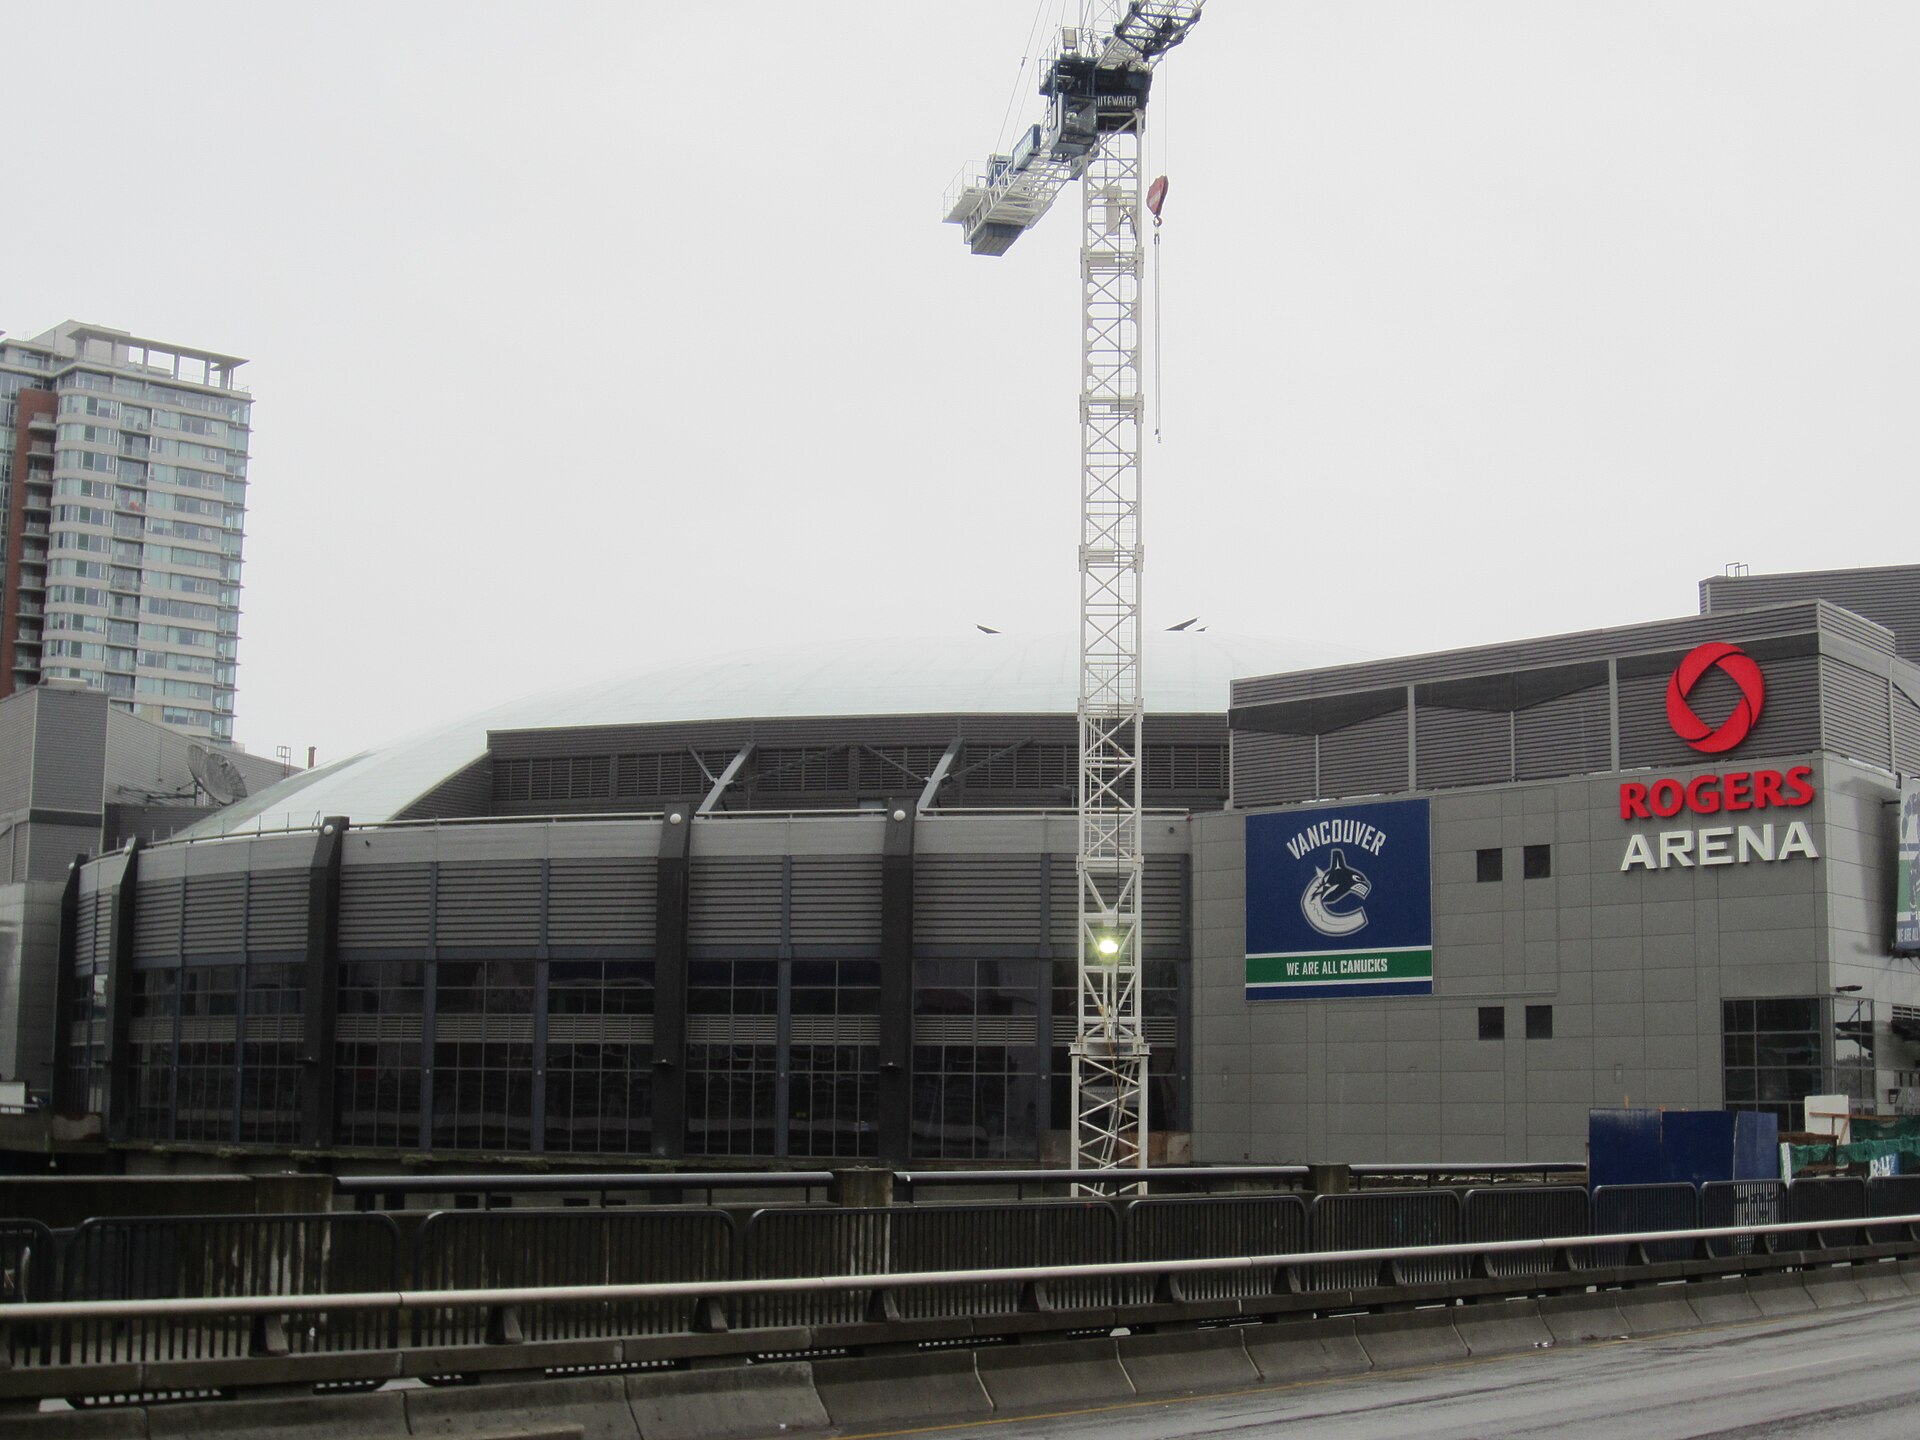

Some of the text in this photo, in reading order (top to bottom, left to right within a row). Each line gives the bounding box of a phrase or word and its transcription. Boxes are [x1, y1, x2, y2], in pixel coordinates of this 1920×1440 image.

[1619, 765, 1815, 820] ROGERS
[1286, 819, 1387, 860] VANCOUVER
[1619, 821, 1820, 871] ARENA
[1286, 958, 1388, 976] WE ARE ALL CANUCKS
